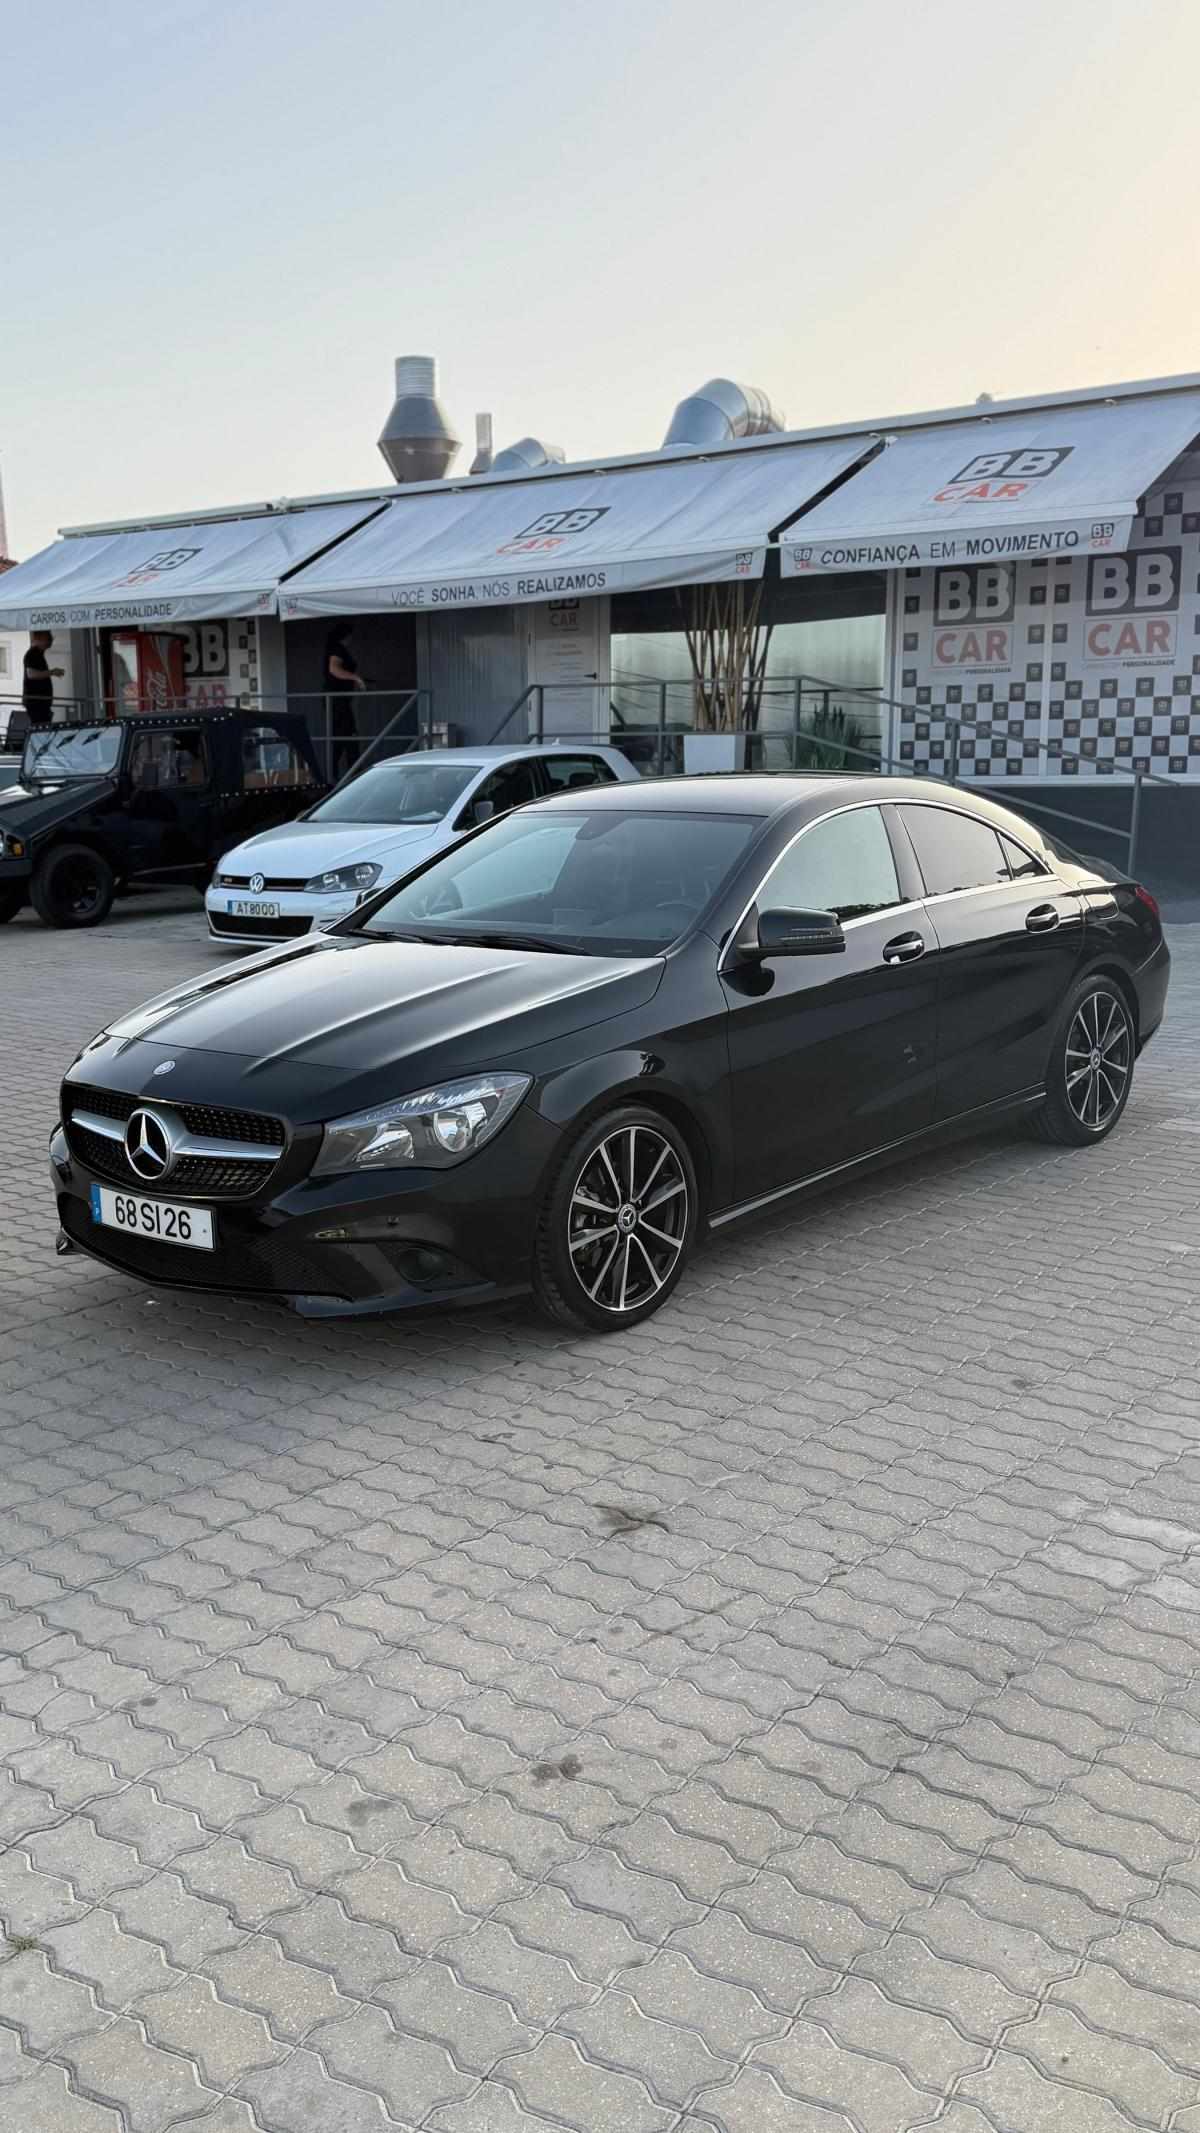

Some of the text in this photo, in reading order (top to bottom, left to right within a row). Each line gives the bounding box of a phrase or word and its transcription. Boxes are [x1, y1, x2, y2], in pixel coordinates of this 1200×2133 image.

[950, 448, 1066, 484] BB
[933, 483, 1029, 502] CAR
[516, 507, 605, 538] BB
[1092, 523, 1113, 538] BB
[820, 530, 1079, 564] CONFIANÇA EM MOVIMENTO
[391, 587, 425, 606] VOCÊ
[482, 577, 511, 598] NÓS
[517, 572, 606, 595] REALIZAMOS
[937, 567, 1011, 621] BB
[1091, 553, 1175, 612] BB
[30, 603, 172, 625] CARROS COM PERSONALIDADE
[935, 629, 1009, 664] CAR
[1088, 620, 1171, 657] CAR
